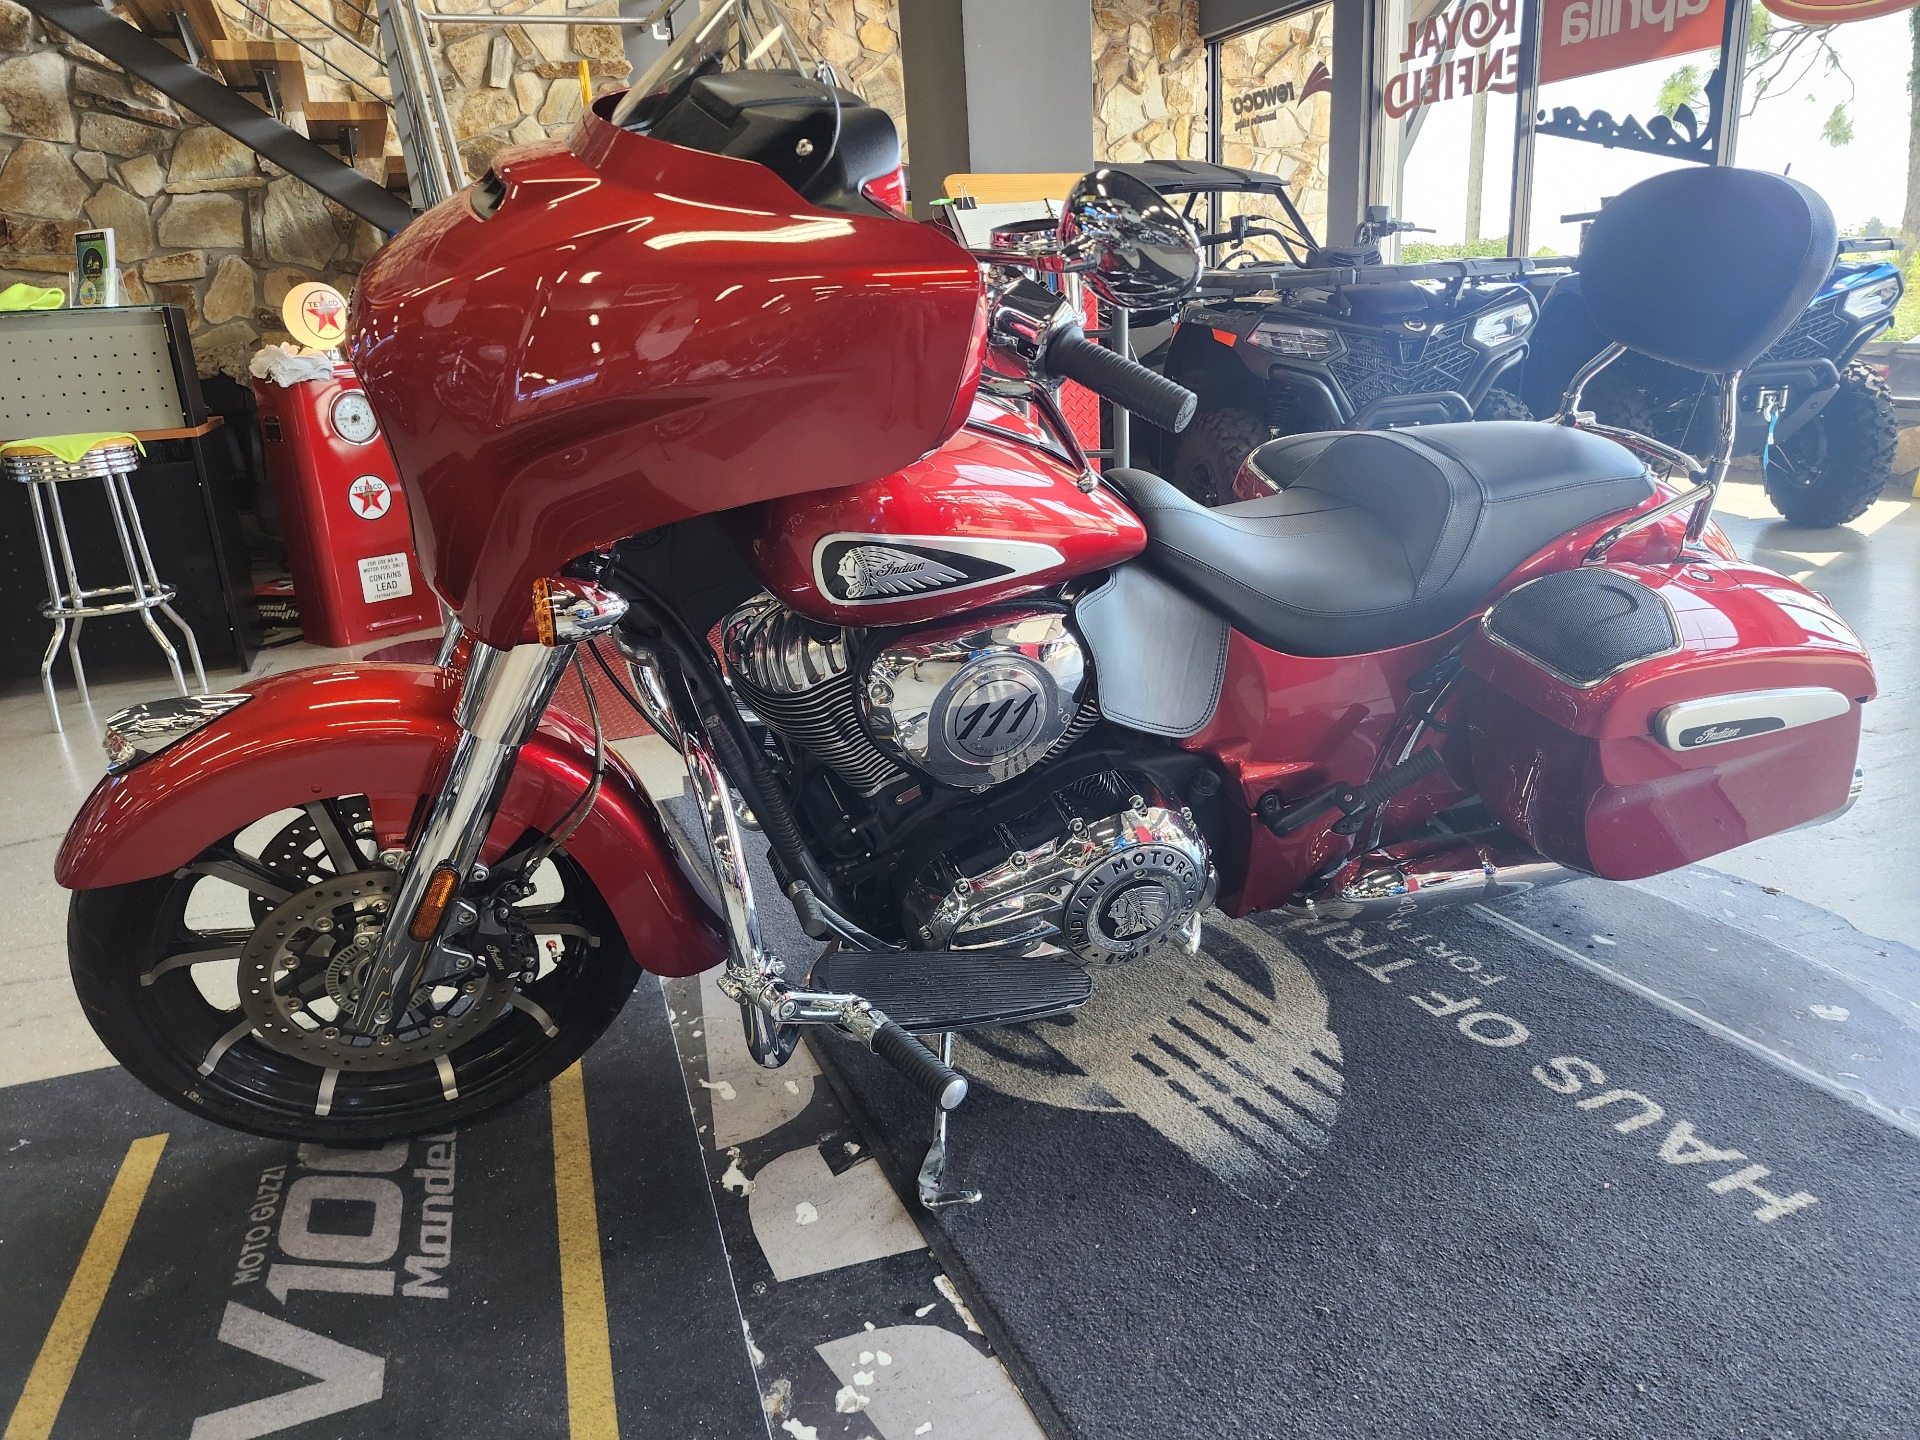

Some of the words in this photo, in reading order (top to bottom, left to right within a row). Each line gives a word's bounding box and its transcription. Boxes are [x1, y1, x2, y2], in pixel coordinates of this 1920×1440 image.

[354, 483, 383, 492] TEXACO
[369, 570, 402, 582] CONTAINS
[376, 580, 398, 592] LEAD
[877, 561, 927, 577] Indian
[956, 693, 1038, 741] 111
[1694, 727, 1741, 744] Indian
[1069, 875, 1107, 952] INDIAN
[1111, 850, 1197, 932] MOTORCYCLE
[485, 944, 505, 971] Indian
[1104, 945, 1151, 965] 1901
[1402, 933, 1508, 987] FORT
[1410, 990, 1531, 1048] OF
[1531, 1055, 1819, 1224] HAUS
[248, 1163, 287, 1222] GUZZI
[231, 1224, 272, 1287] MOTO
